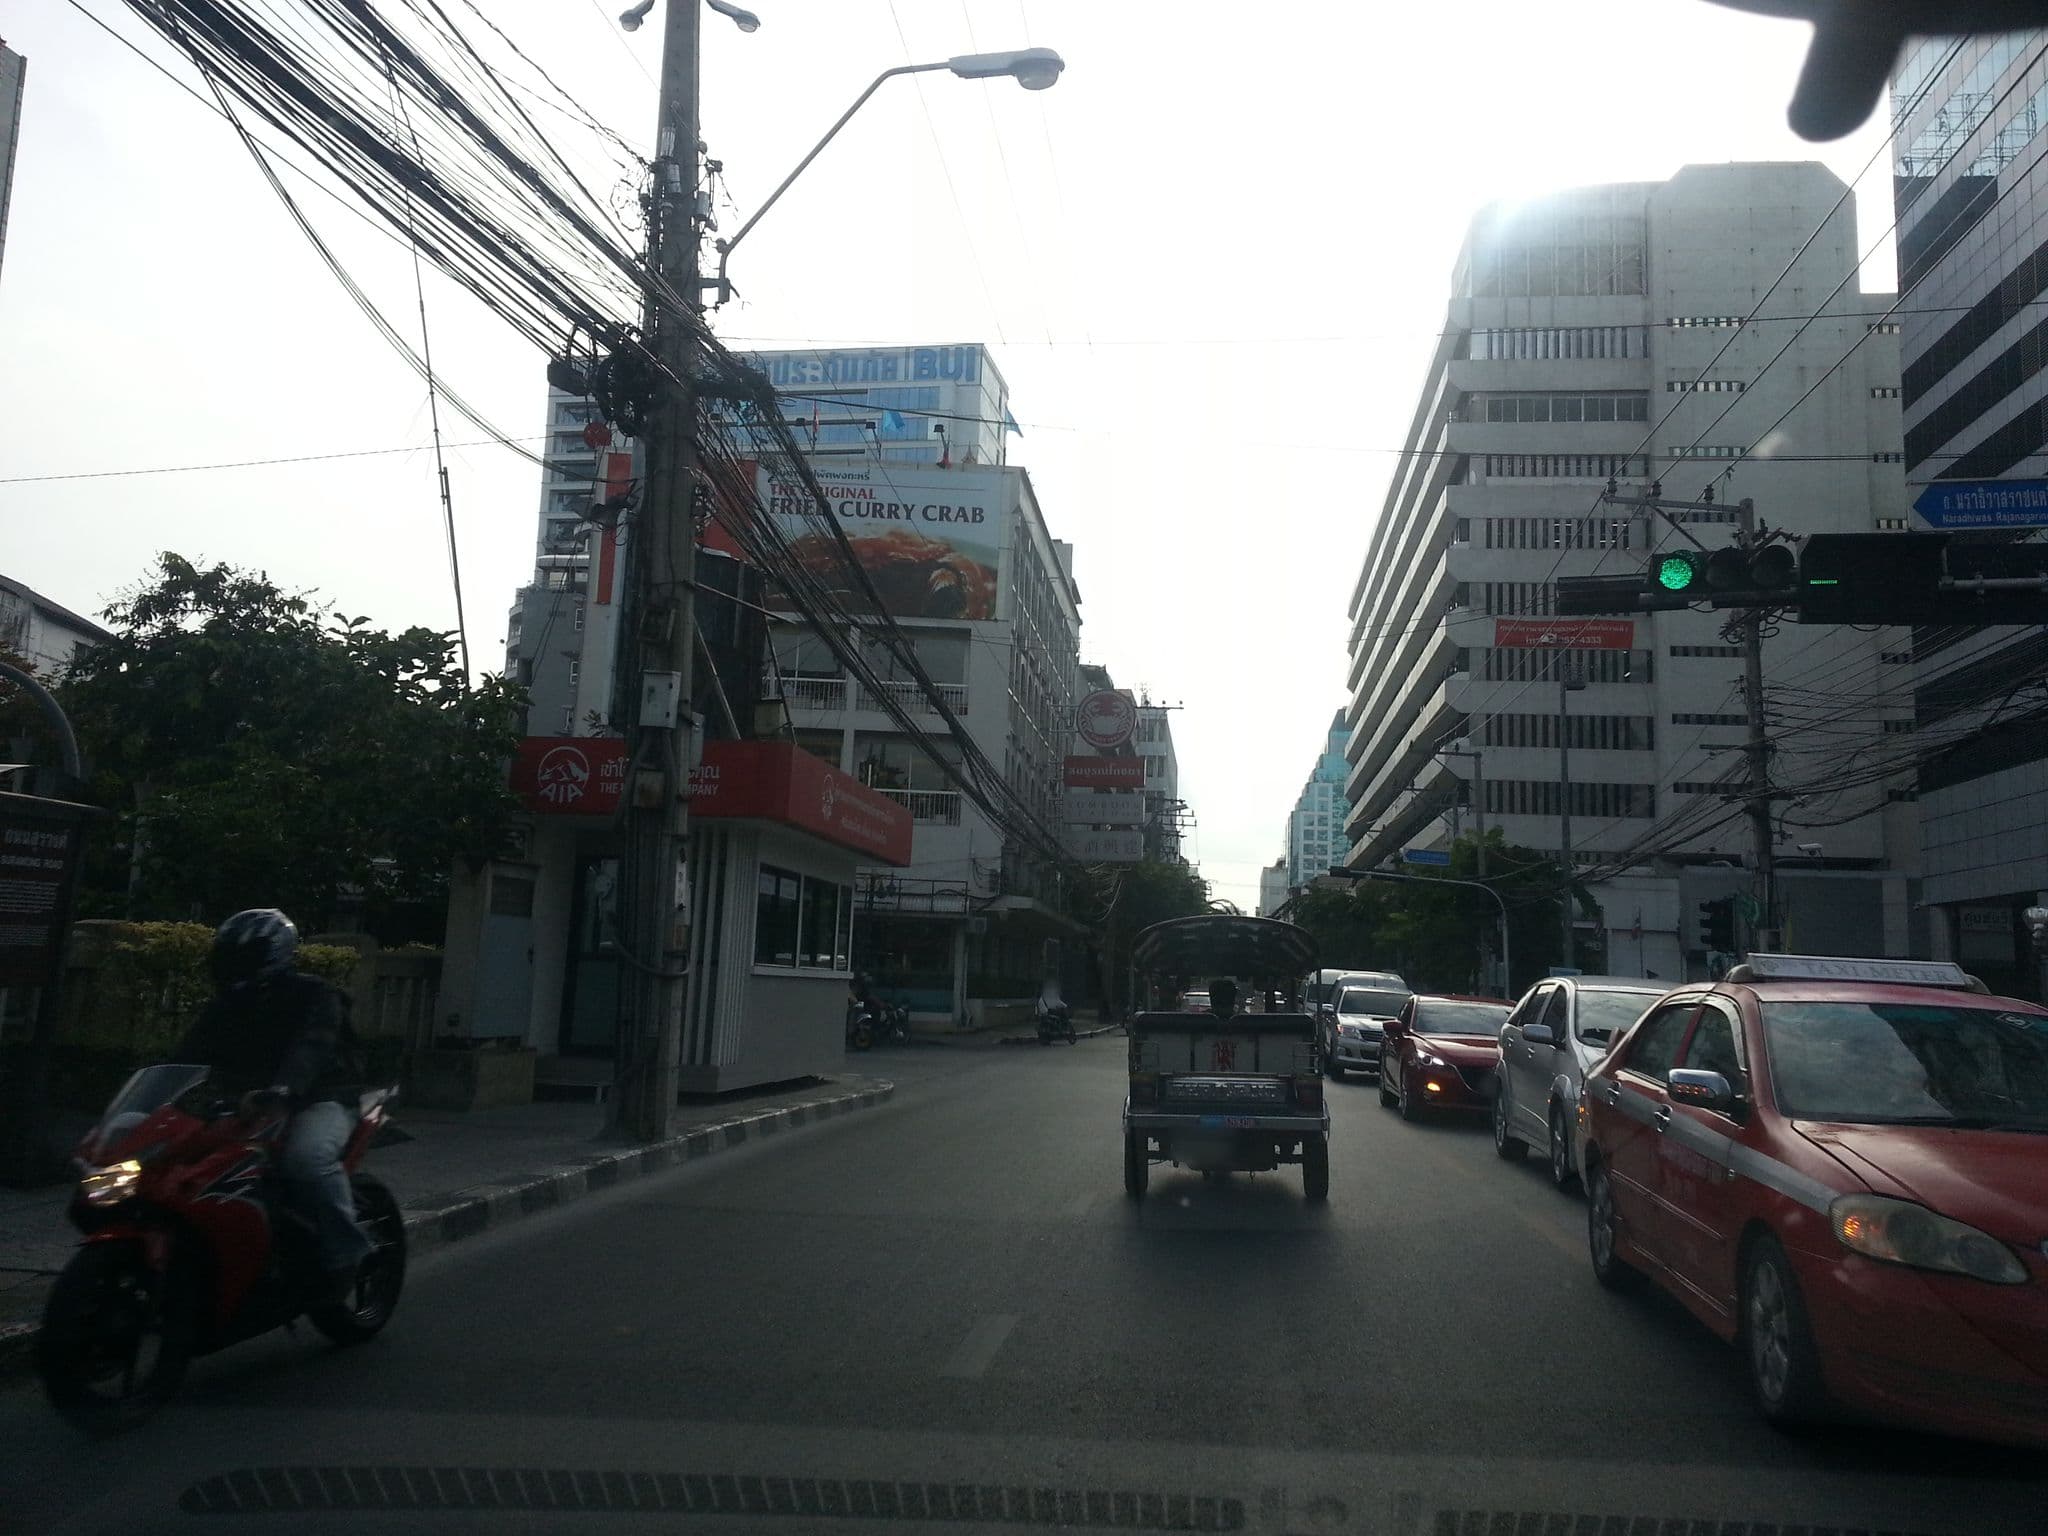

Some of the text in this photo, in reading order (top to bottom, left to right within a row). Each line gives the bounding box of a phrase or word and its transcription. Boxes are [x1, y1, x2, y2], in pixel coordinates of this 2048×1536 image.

[913, 346, 977, 381] BUI
[838, 500, 920, 520] CURRY
[921, 504, 985, 524] CRAB
[1943, 511, 2048, 524] Naradhiwas Rajanagarin
[539, 783, 585, 803] AIA
[600, 782, 618, 794] THE
